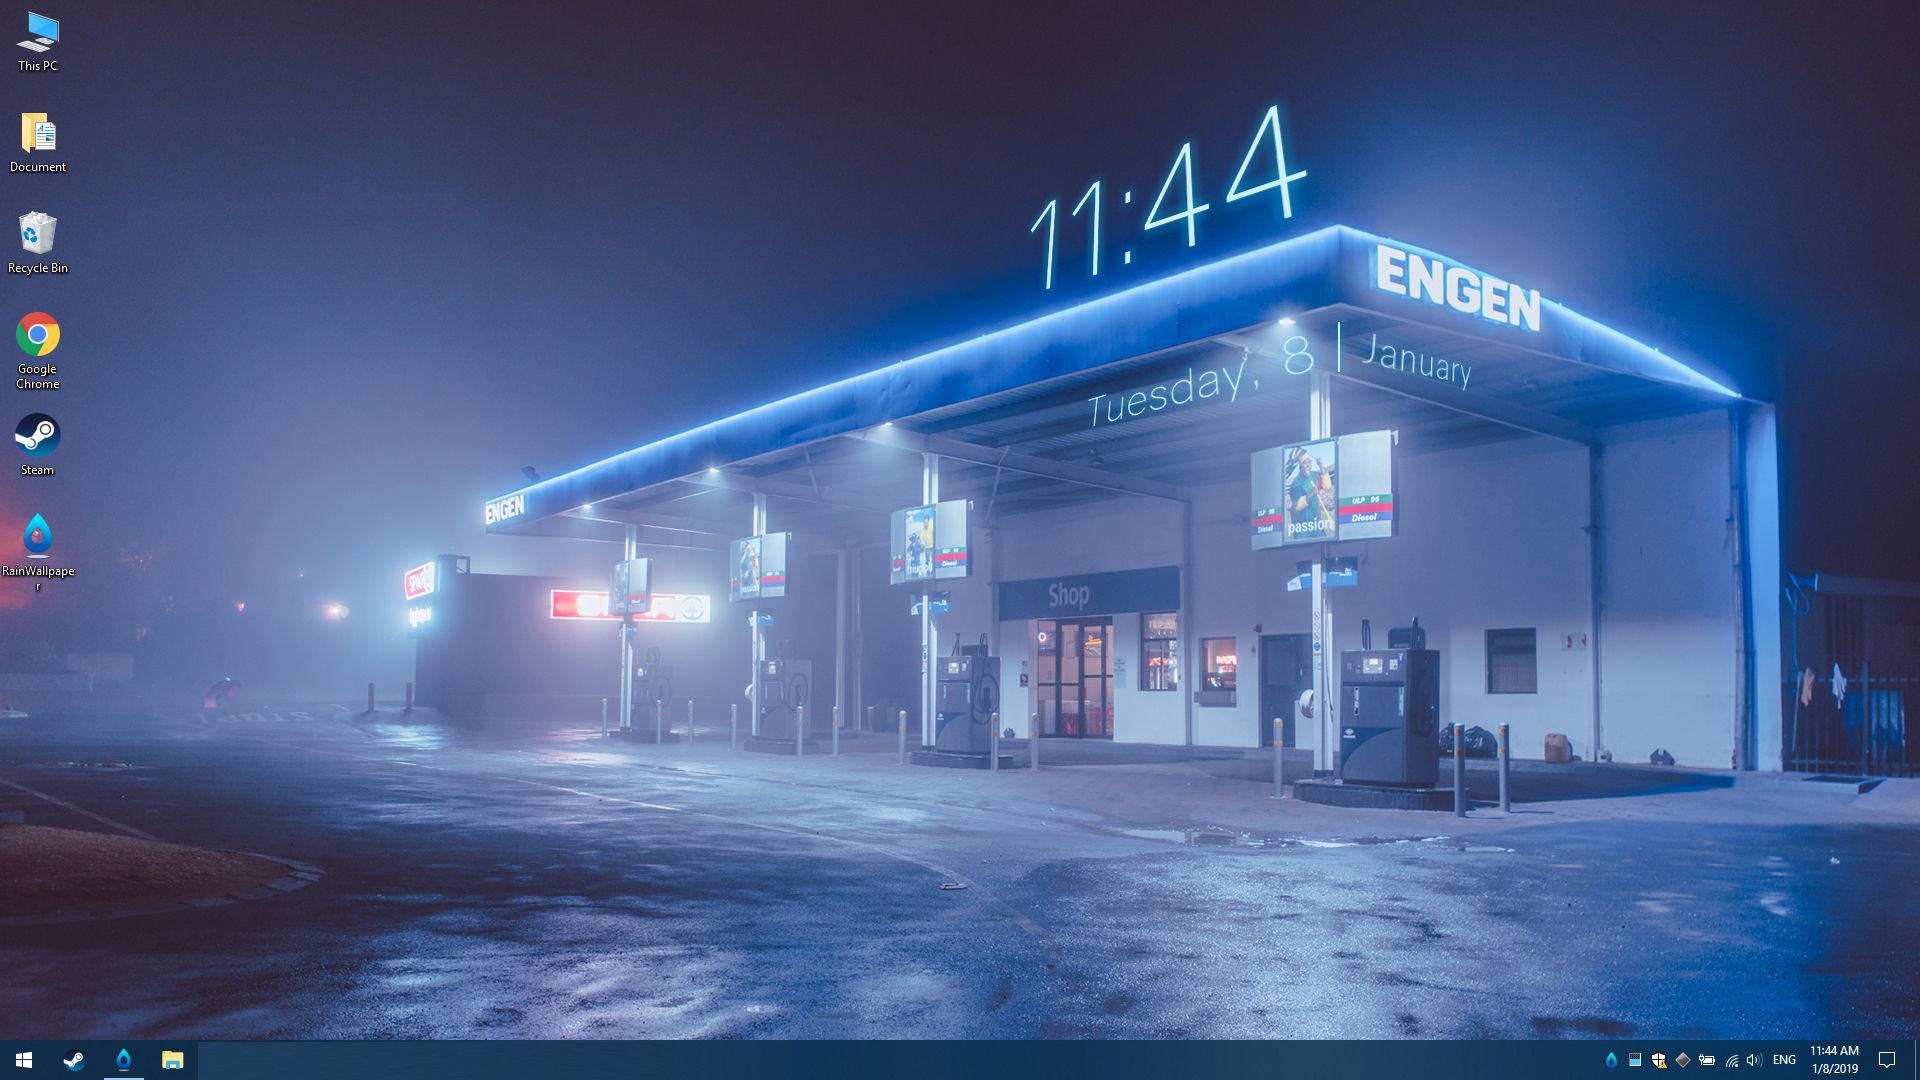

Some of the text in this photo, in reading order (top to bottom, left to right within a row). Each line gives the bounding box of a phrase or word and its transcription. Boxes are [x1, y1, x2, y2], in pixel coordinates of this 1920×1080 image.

[1376, 244, 1541, 332] ENGEN
[485, 494, 525, 525] ENGEN
[1351, 512, 1377, 522] Diesel
[1288, 517, 1334, 537] passion
[1049, 582, 1090, 611] Shop
